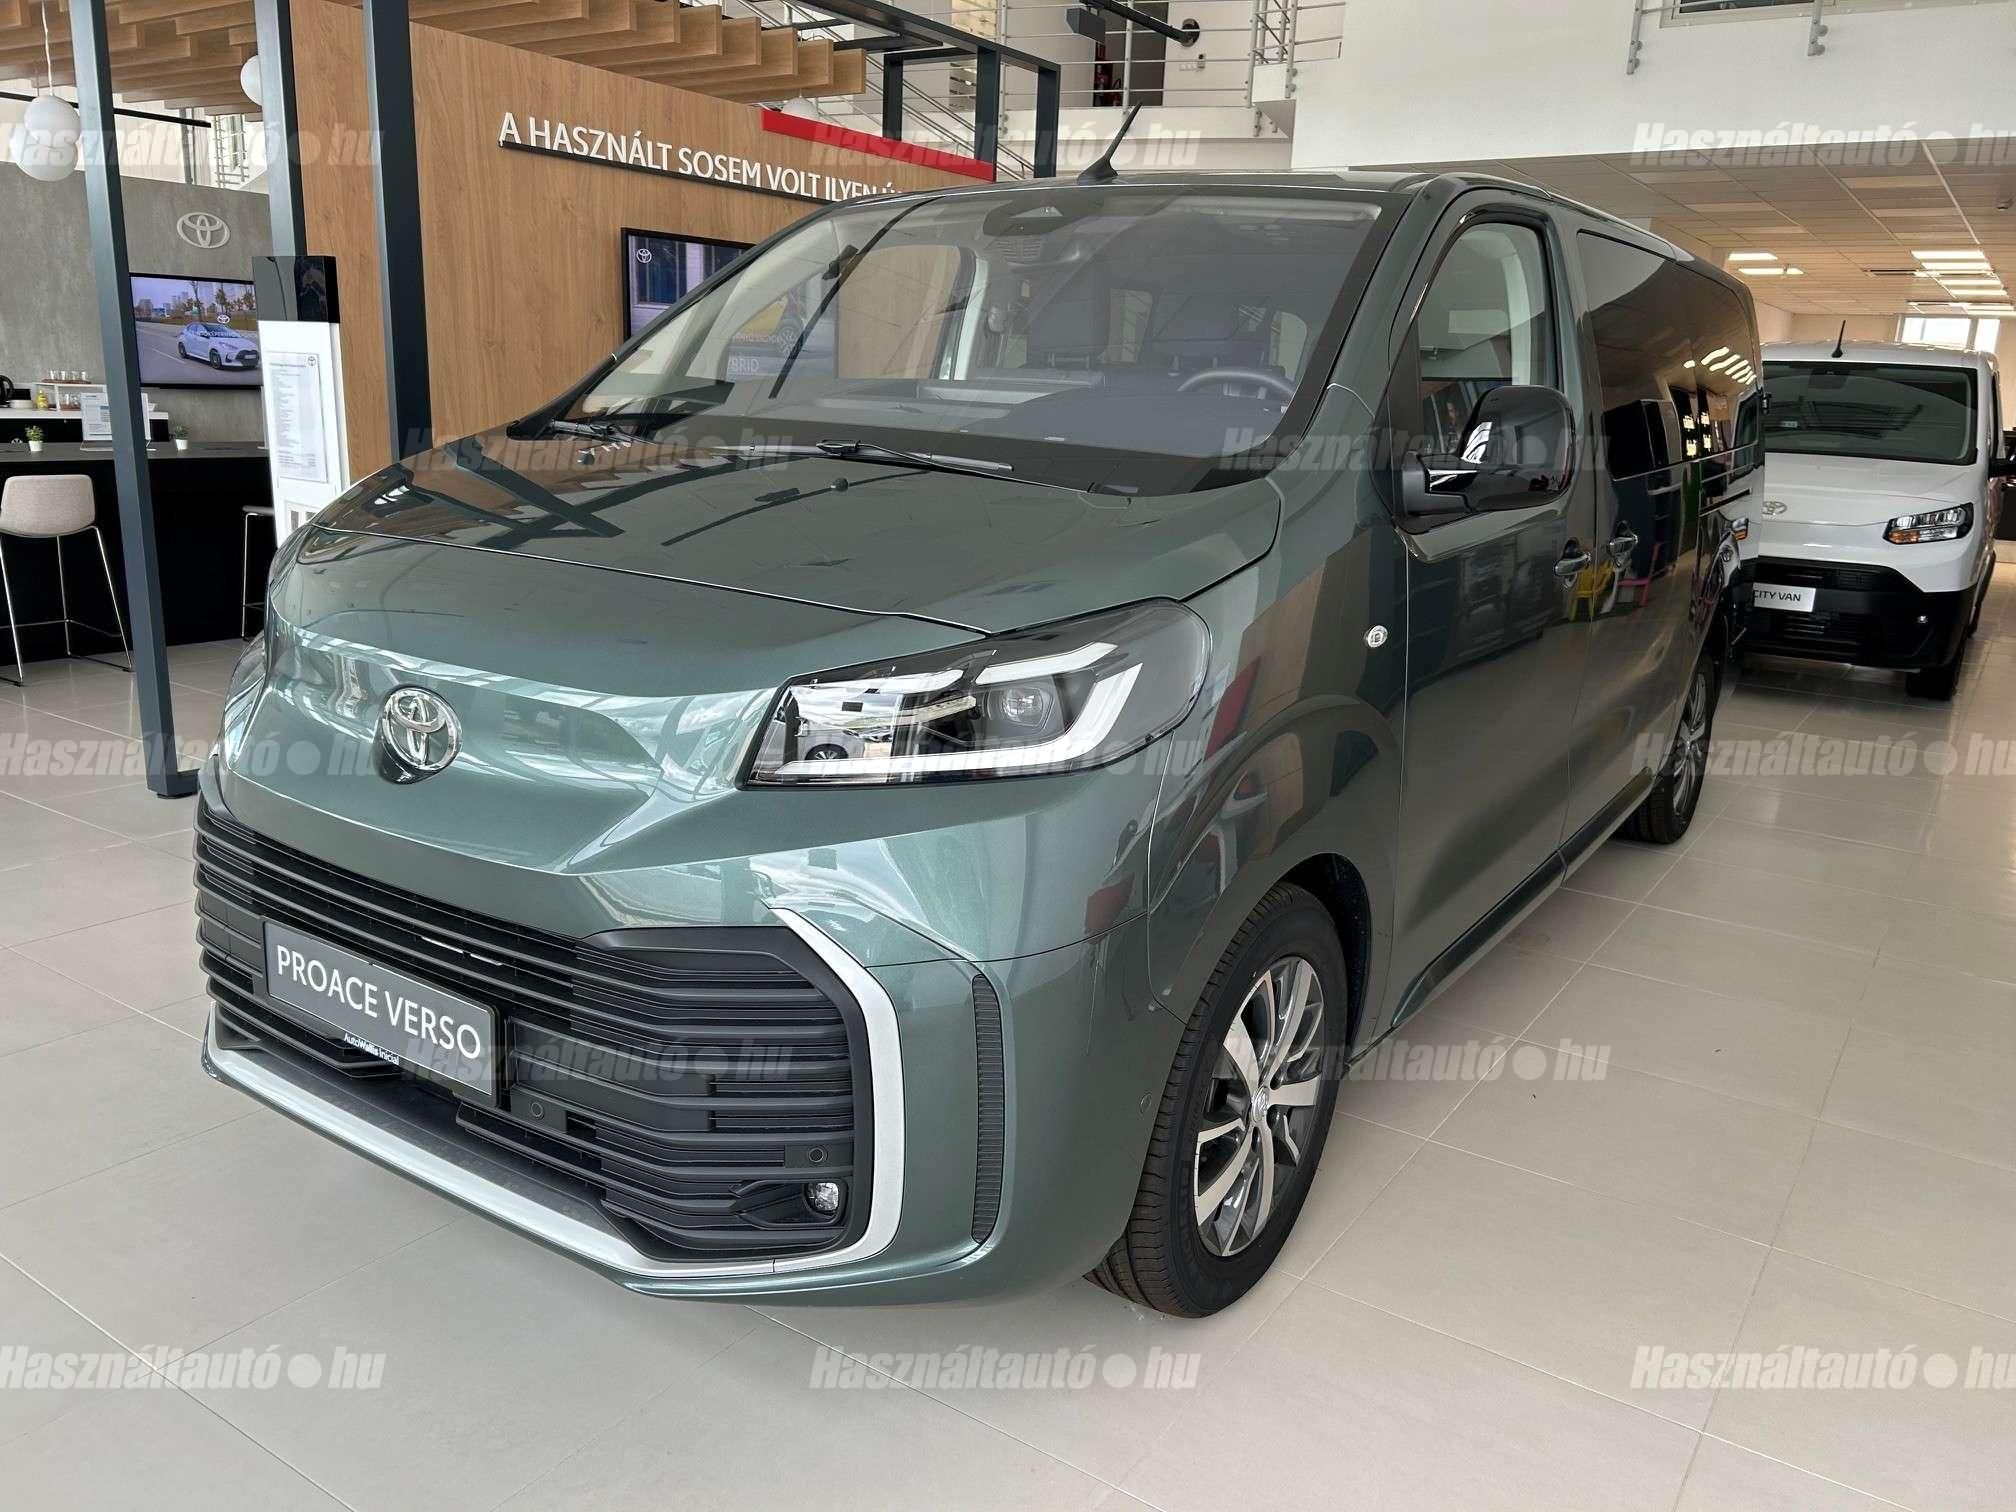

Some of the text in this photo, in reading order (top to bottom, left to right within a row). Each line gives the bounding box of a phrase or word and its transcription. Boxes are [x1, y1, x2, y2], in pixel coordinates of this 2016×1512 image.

[499, 112, 521, 144] A
[529, 116, 672, 171] HASZNÁLT
[678, 147, 762, 188] SOSEM
[764, 163, 821, 198] VOLT
[1778, 591, 1801, 602] VAN
[277, 944, 481, 1060] PROACE VERSO
